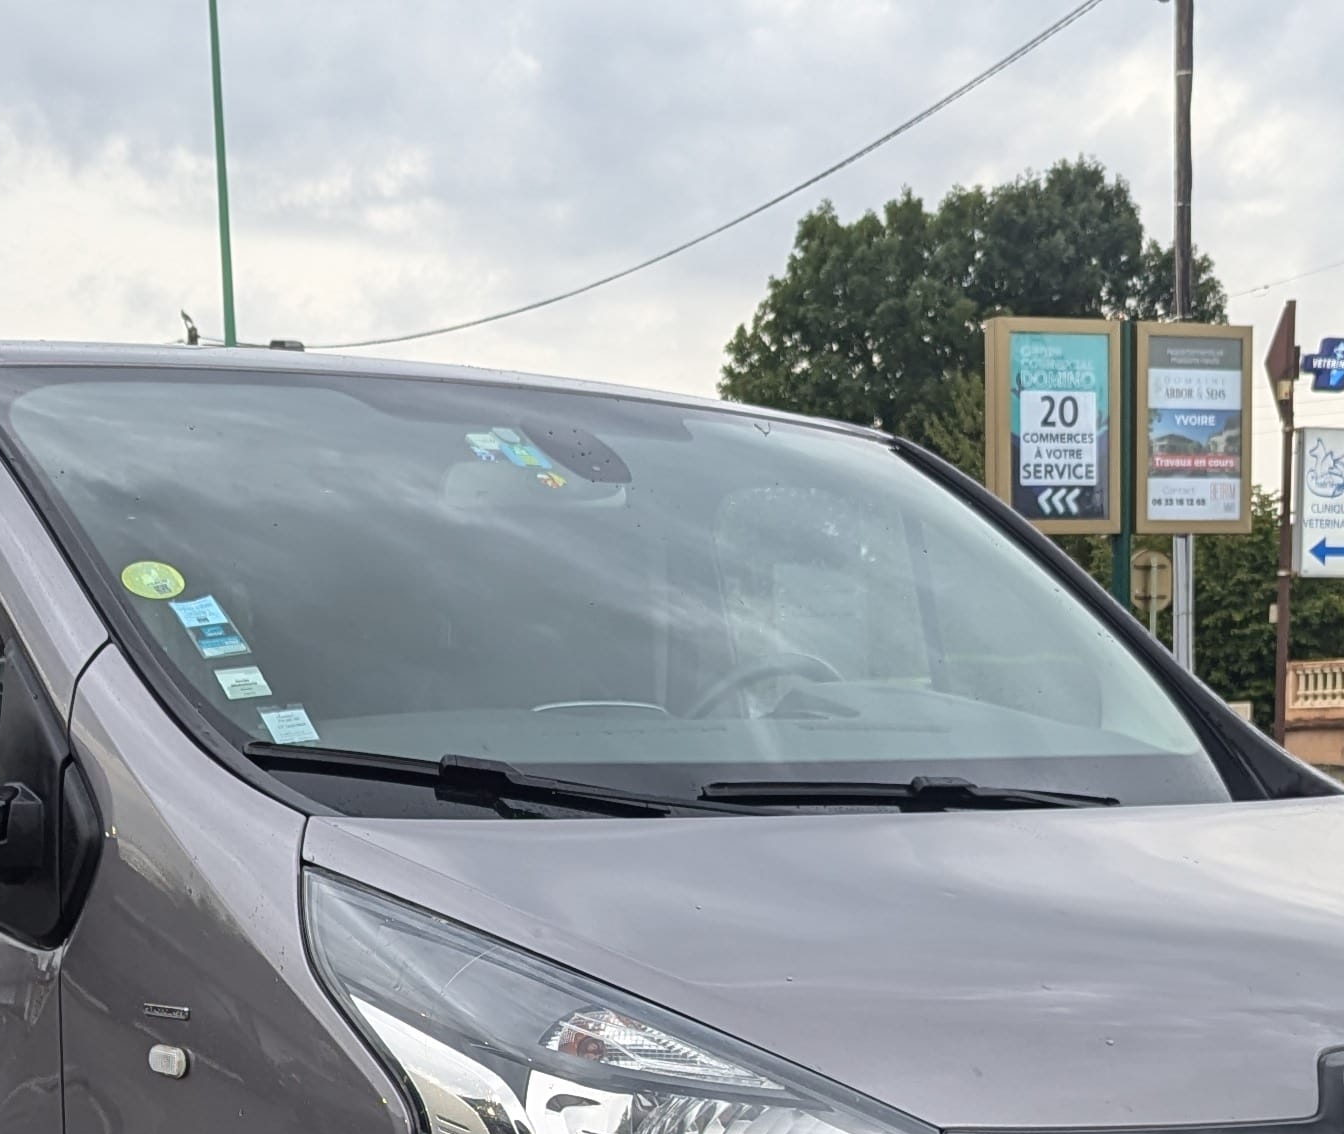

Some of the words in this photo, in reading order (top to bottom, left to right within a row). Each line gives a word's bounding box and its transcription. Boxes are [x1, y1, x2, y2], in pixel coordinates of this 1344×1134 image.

[1020, 370, 1095, 388] DOMINO
[1040, 395, 1079, 428] 20
[1174, 414, 1216, 427] YVOIRE
[1022, 433, 1094, 444] COMMERCES
[1045, 449, 1083, 460] VOTRE
[1155, 457, 1192, 467] Travaux
[1194, 459, 1206, 467] en
[1208, 459, 1235, 468] cours
[1022, 463, 1095, 480] SERVICE
